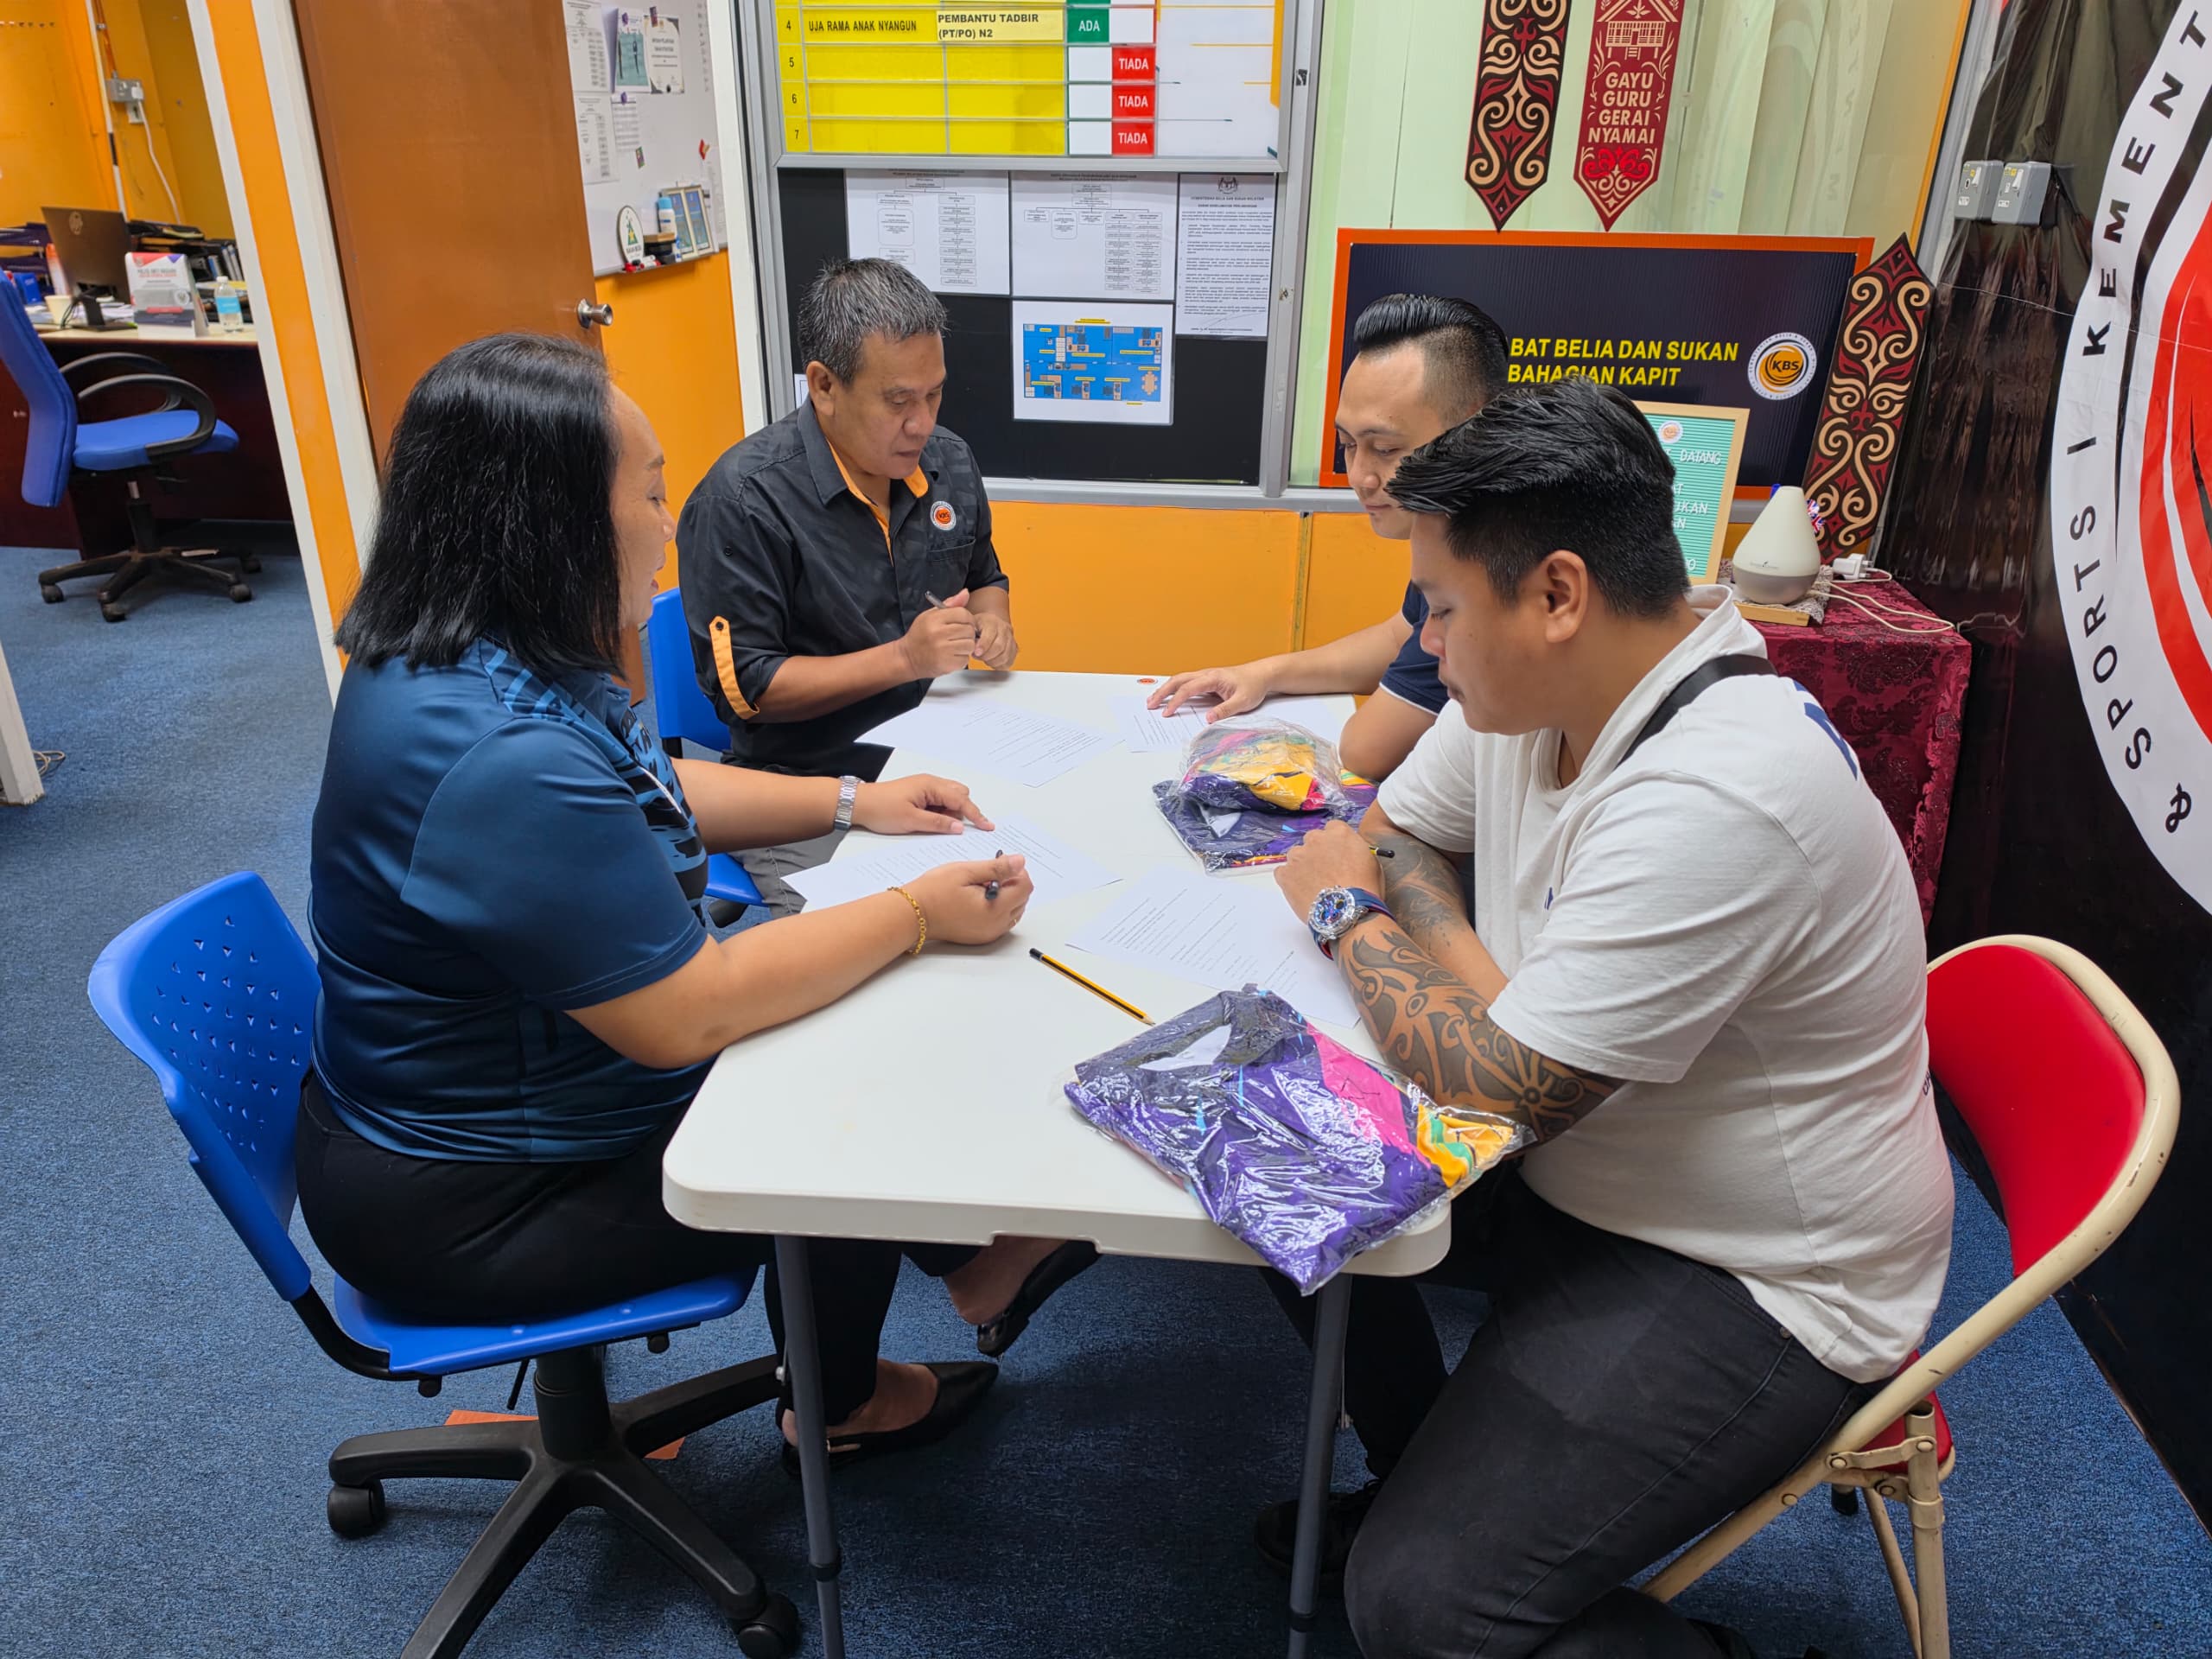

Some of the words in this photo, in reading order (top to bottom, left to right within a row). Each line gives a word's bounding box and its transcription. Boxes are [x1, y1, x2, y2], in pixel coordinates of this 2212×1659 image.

[938, 14, 996, 23] PEMBANTU
[999, 14, 1039, 22] TADBIR
[786, 20, 791, 30] 4
[808, 21, 824, 31] UJA
[827, 21, 850, 31] RAMA
[853, 21, 875, 31] ANAK
[878, 20, 917, 31] NYANGUN
[1078, 20, 1101, 32] ADA
[938, 29, 976, 40] (PT/PO)
[979, 29, 994, 38] N2
[789, 56, 795, 67] 5
[1118, 58, 1149, 70] TIADA
[1605, 72, 1654, 89] GAYU
[791, 93, 798, 104] 6
[1118, 95, 1148, 107] TIADA
[1602, 90, 1651, 107] GURU
[1599, 109, 1650, 126] GERAI
[794, 129, 799, 139] 7
[1117, 132, 1148, 144] TIADA
[1588, 127, 1656, 144] NYAMAI
[1554, 339, 1614, 359] BELIA
[1618, 340, 1662, 359] DAN
[1666, 340, 1738, 361] SUKAN
[1772, 360, 1800, 372] KBS
[1618, 366, 1681, 386] KAPIT
[2069, 505, 2153, 770] SPORTS
